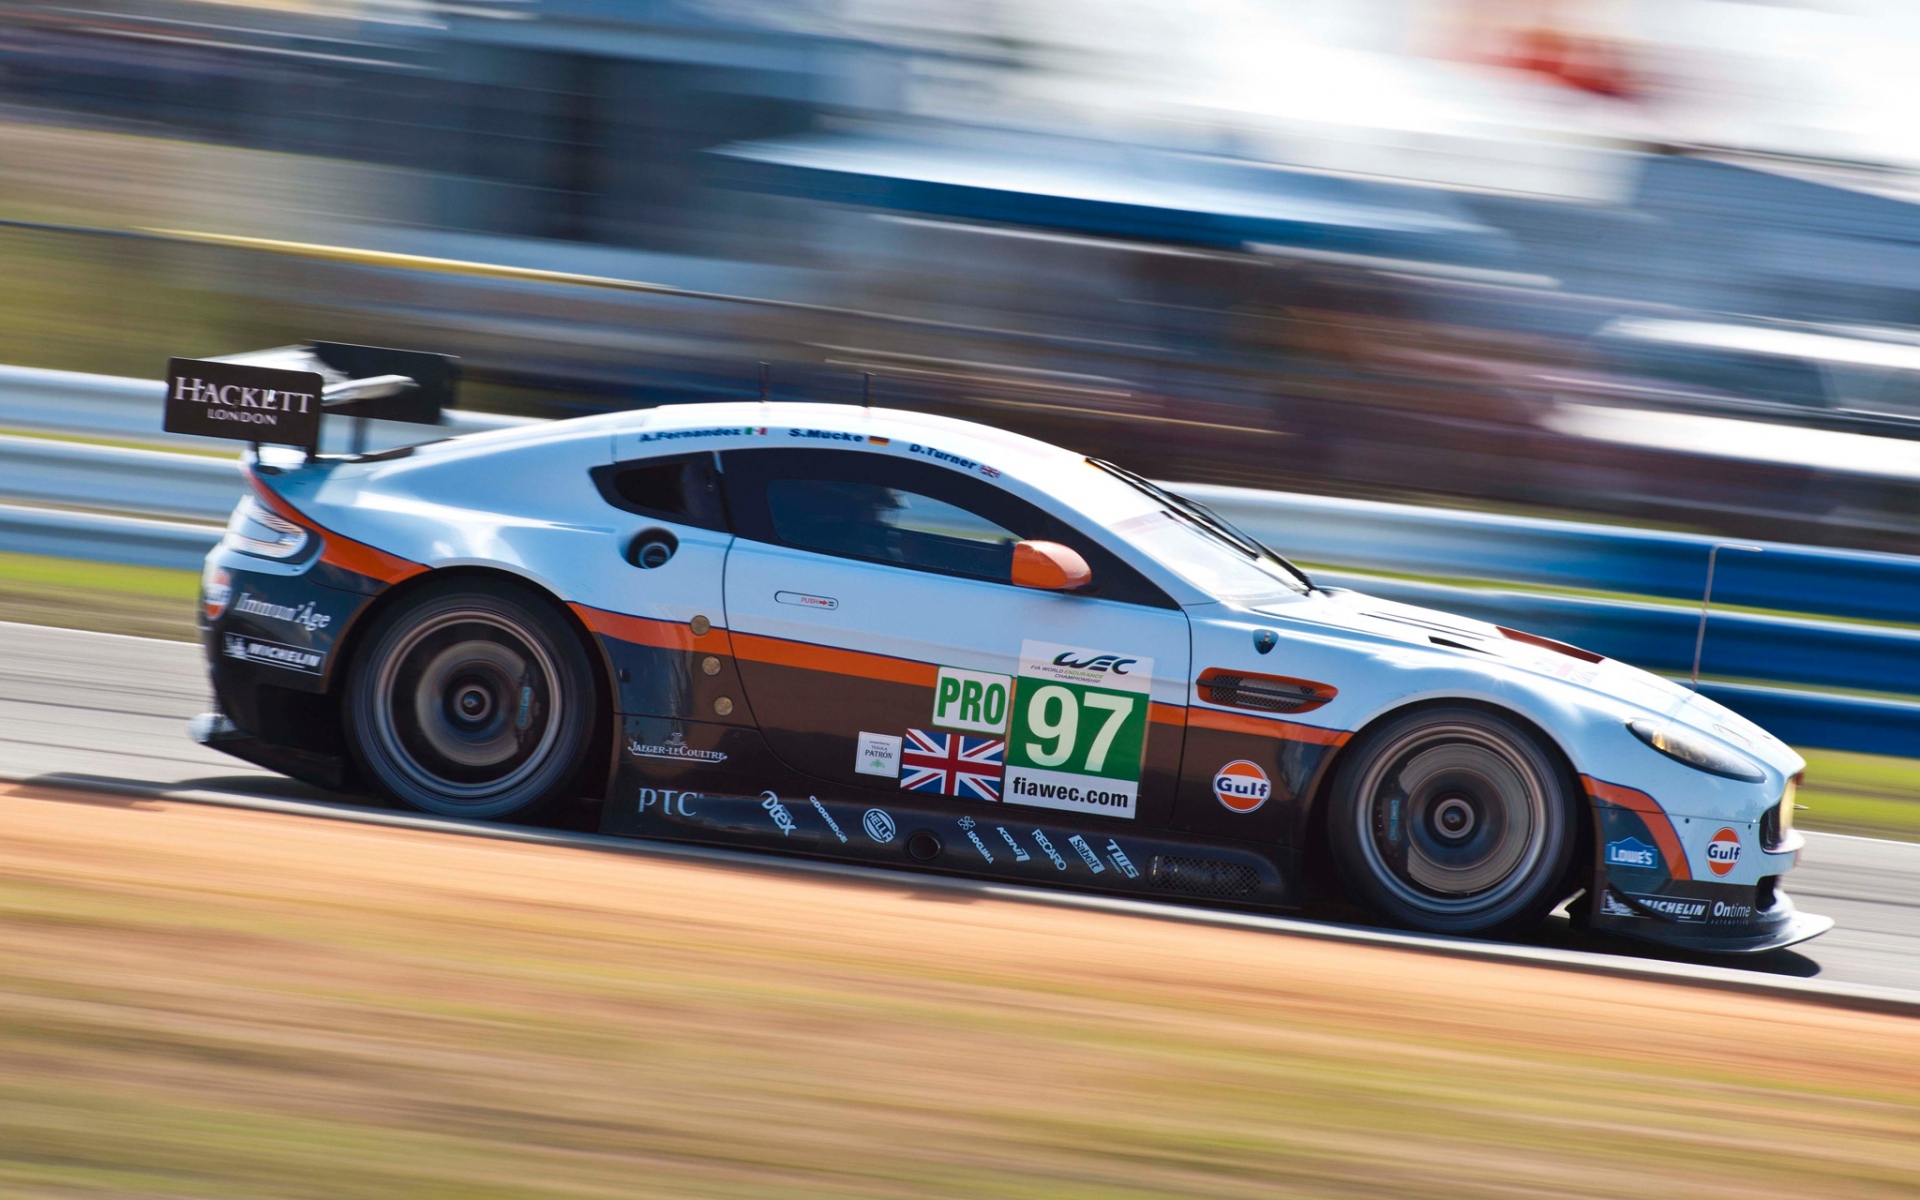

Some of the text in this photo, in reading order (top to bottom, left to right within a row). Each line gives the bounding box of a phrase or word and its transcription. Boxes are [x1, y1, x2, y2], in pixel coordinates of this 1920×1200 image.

[174, 376, 315, 414] HACKETT
[206, 408, 278, 426] LONDON
[908, 442, 977, 470] D.Turner
[801, 596, 819, 605] PUSH
[247, 642, 321, 667] MICHELIN
[1052, 651, 1137, 675] WEC
[1041, 666, 1063, 675] WORLD
[1063, 668, 1104, 680] ENDURANCE
[1054, 672, 1102, 685] CHAMPIONSHIP
[936, 676, 1007, 726] PRO
[1025, 684, 1134, 773] 97
[1012, 776, 1128, 808] fiawec.com
[1216, 776, 1269, 797] Gulf
[809, 795, 848, 843] GOODRIDGE
[867, 811, 894, 843] HELLA
[966, 830, 995, 865] ISOCLIMA
[1031, 828, 1067, 871] RECARO
[1072, 838, 1101, 871] Sabelt
[1610, 846, 1653, 866] LOWE'S
[1707, 843, 1741, 861] Gulf
[1713, 901, 1751, 918] Ontime
